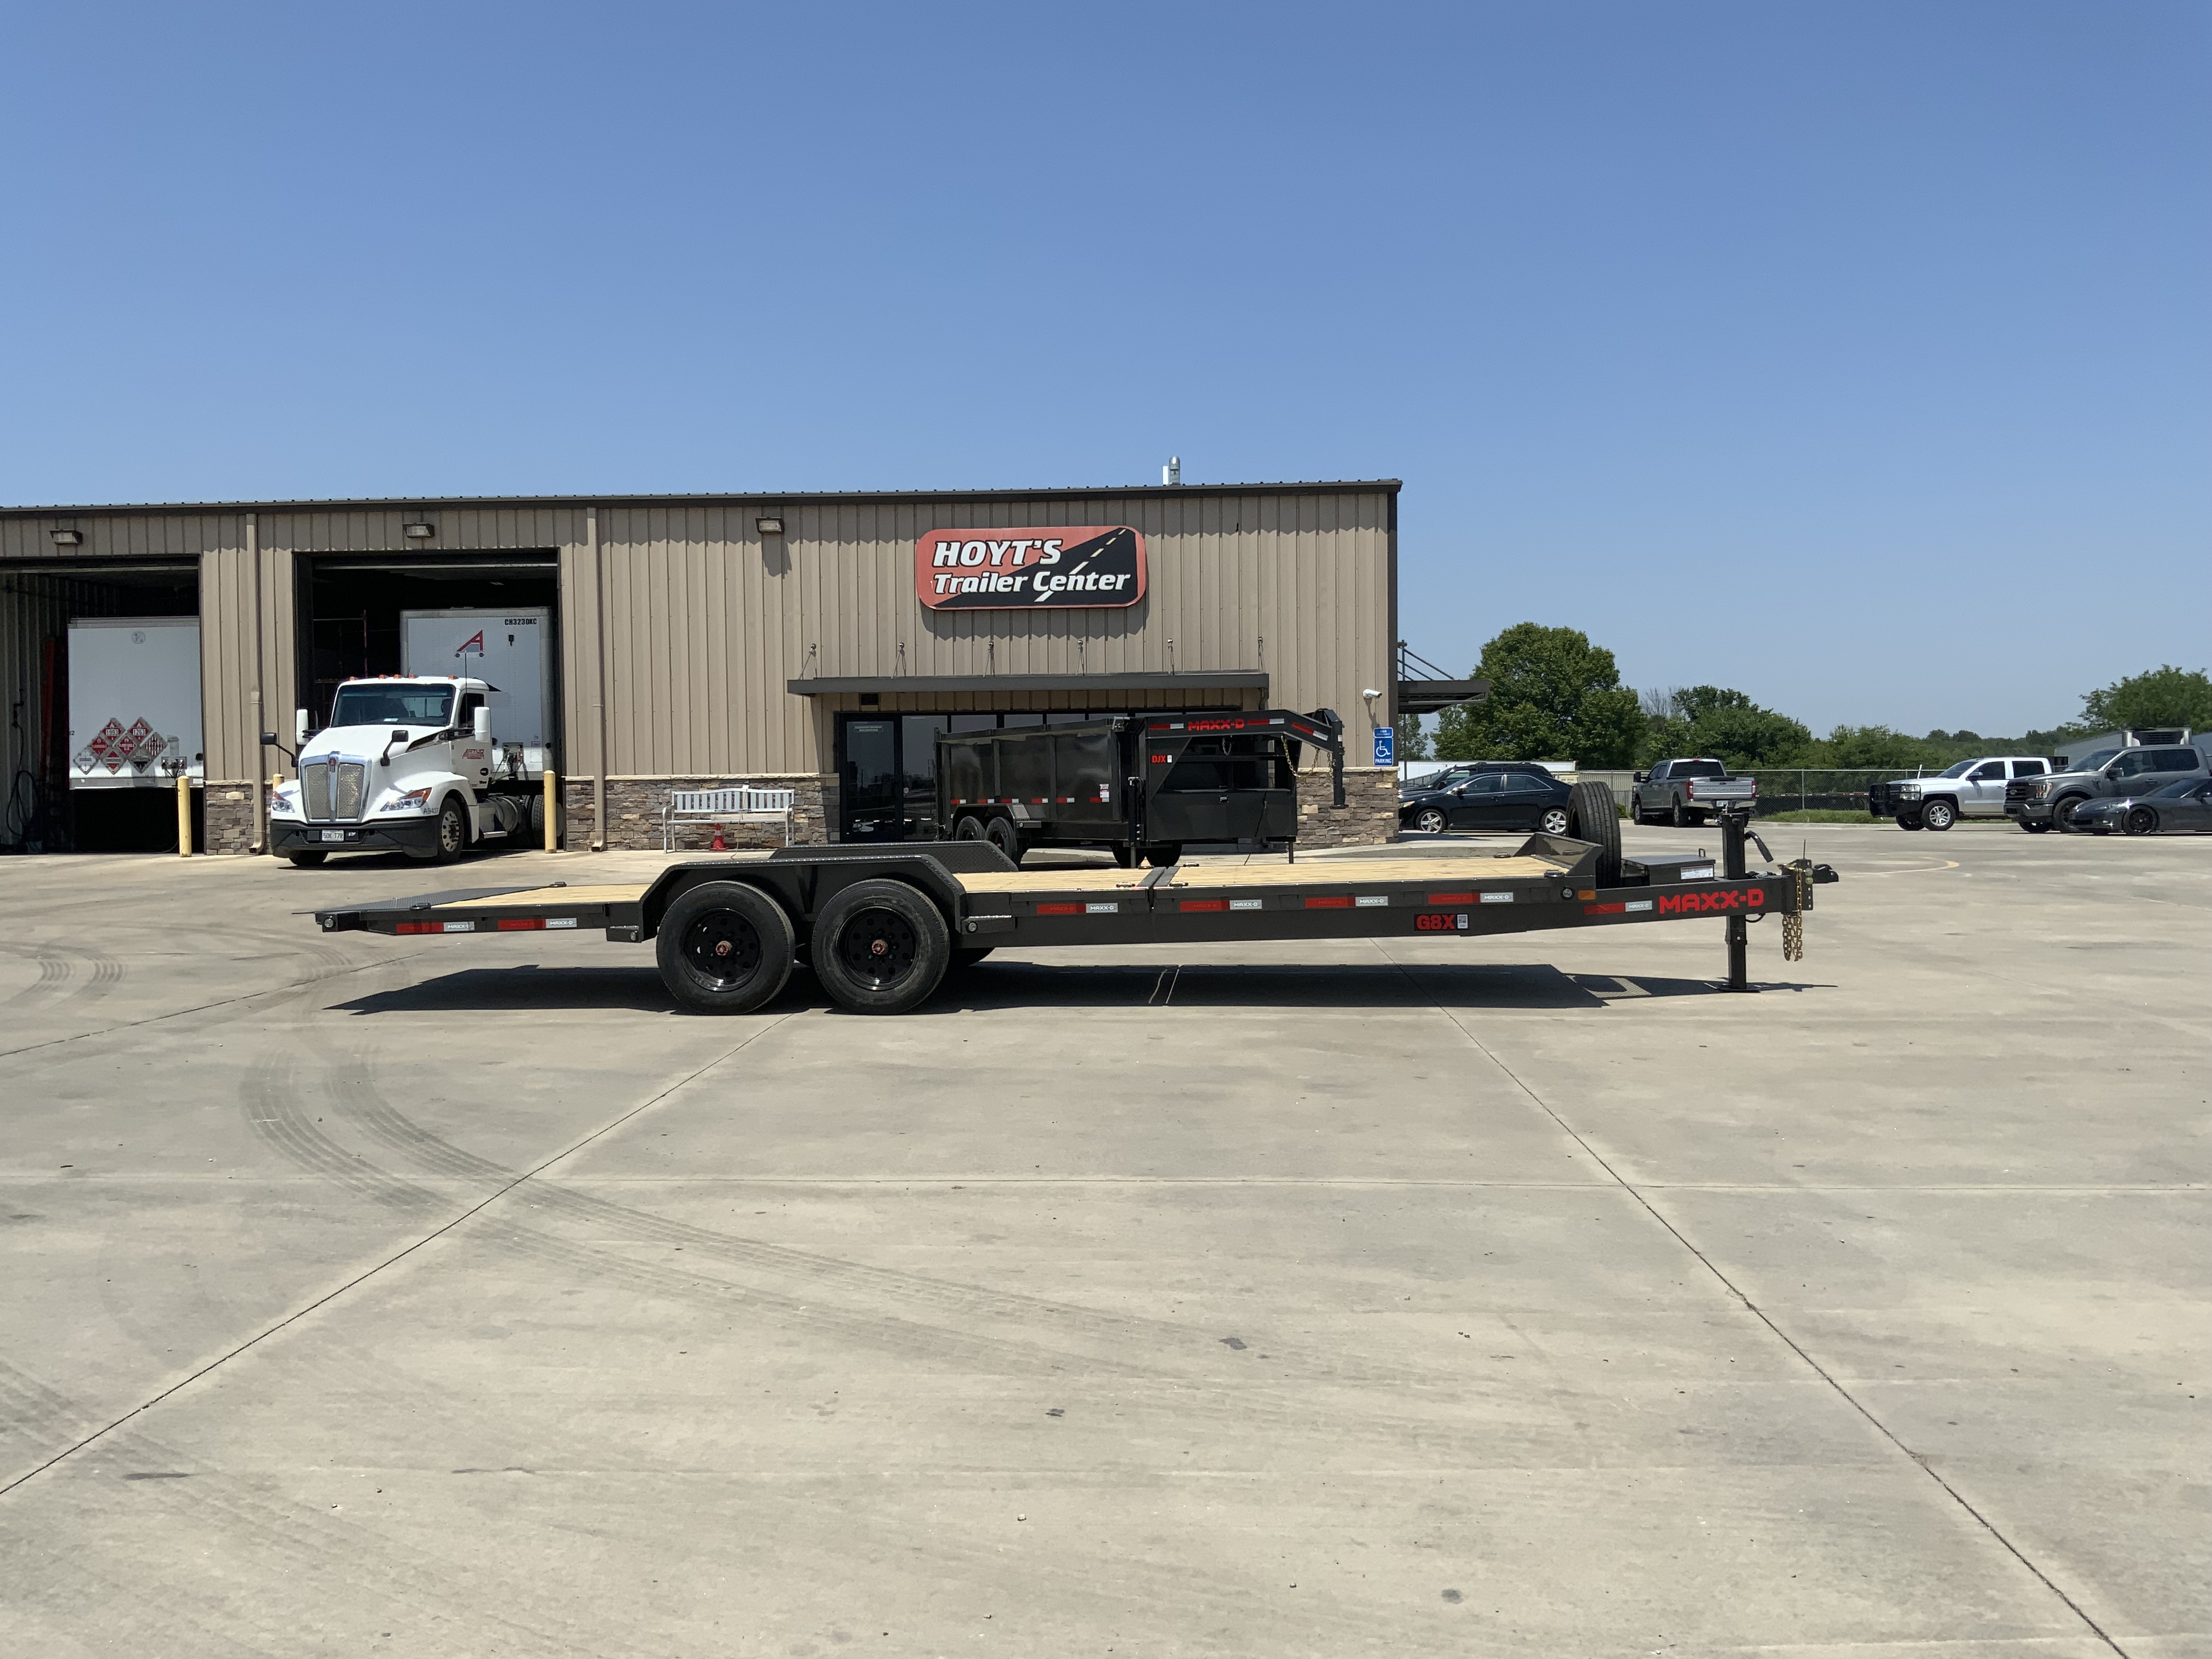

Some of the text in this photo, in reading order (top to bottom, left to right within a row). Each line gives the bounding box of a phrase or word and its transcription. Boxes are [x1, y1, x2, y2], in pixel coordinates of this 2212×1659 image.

[933, 539, 1063, 567] HOYT'S
[934, 571, 1131, 594] Trailer Center
[1187, 718, 1245, 731] MAXX-D
[1152, 755, 1166, 763] DJX
[1659, 888, 1764, 915] MAXX-D
[1417, 914, 1455, 930] G8X
